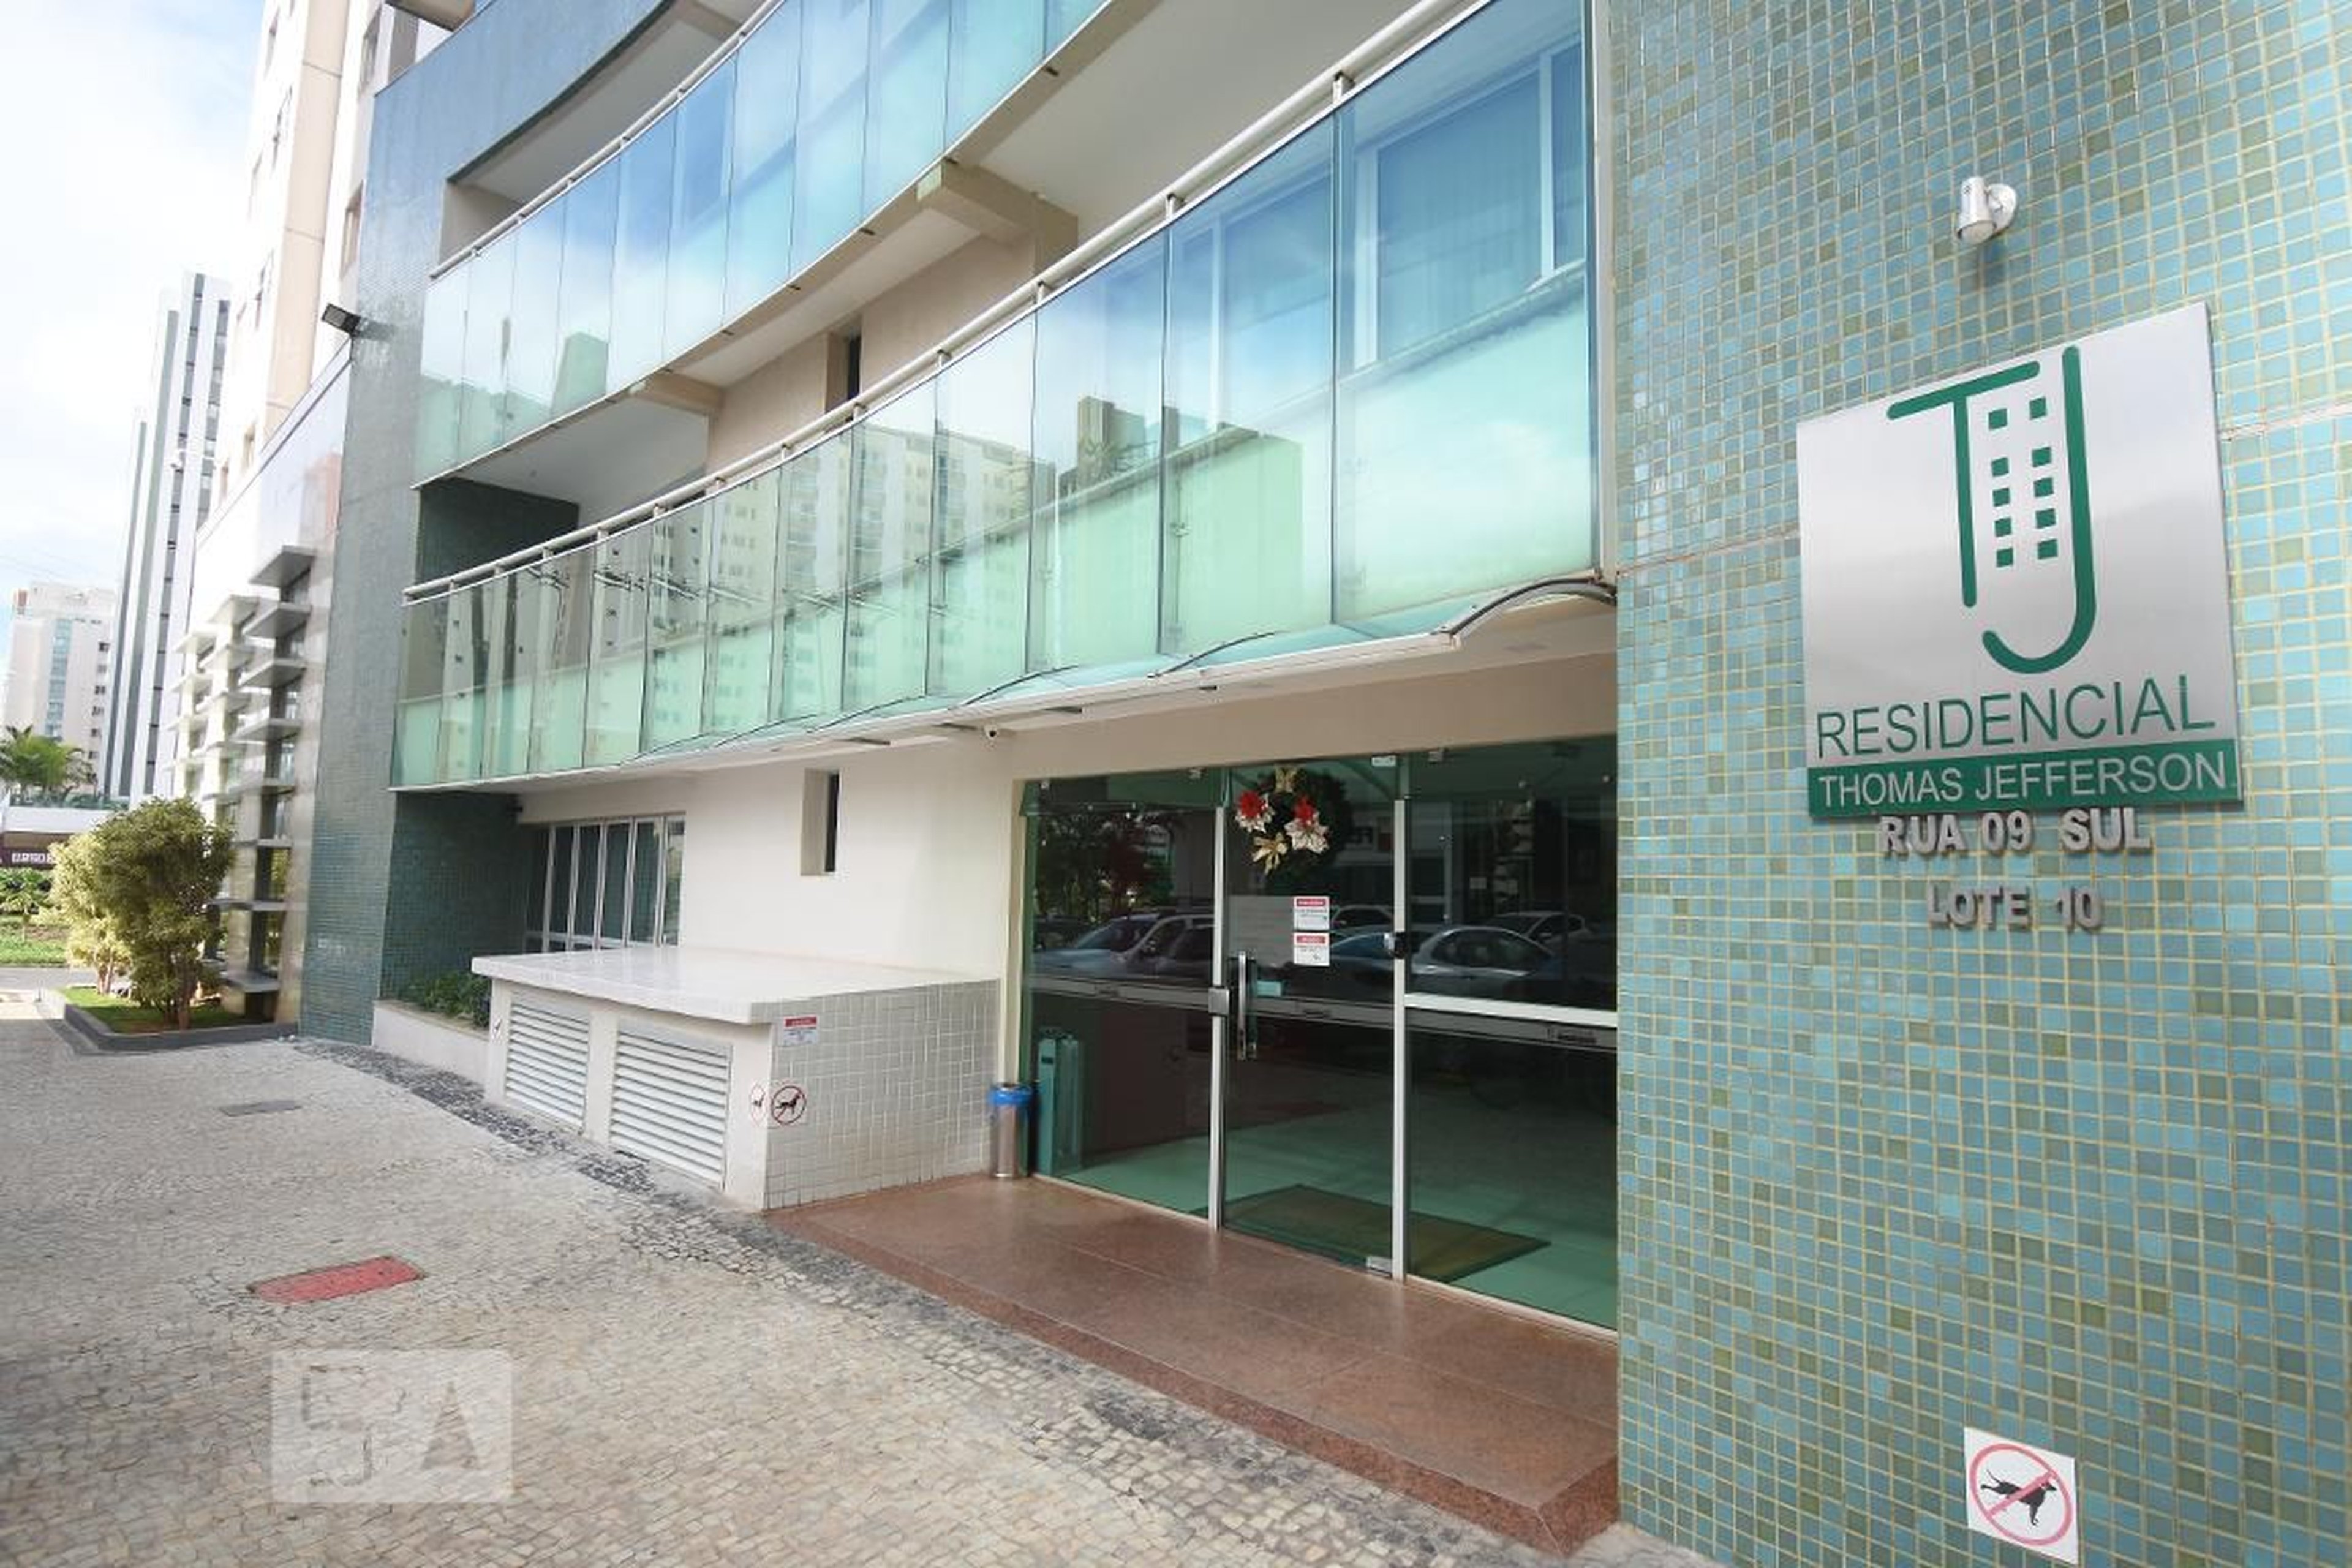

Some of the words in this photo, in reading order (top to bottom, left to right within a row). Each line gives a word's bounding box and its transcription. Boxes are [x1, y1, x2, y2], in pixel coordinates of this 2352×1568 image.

[1816, 675, 2215, 759] RESIDENCIAL
[1819, 767, 1962, 807] THOMAS
[1975, 750, 2226, 801] JEFFERSON
[1878, 813, 1967, 856] RUA
[1981, 810, 2035, 855] 09
[2060, 807, 2152, 853] SUL
[1926, 884, 2030, 929] LOTE
[2055, 886, 2105, 933] 10
